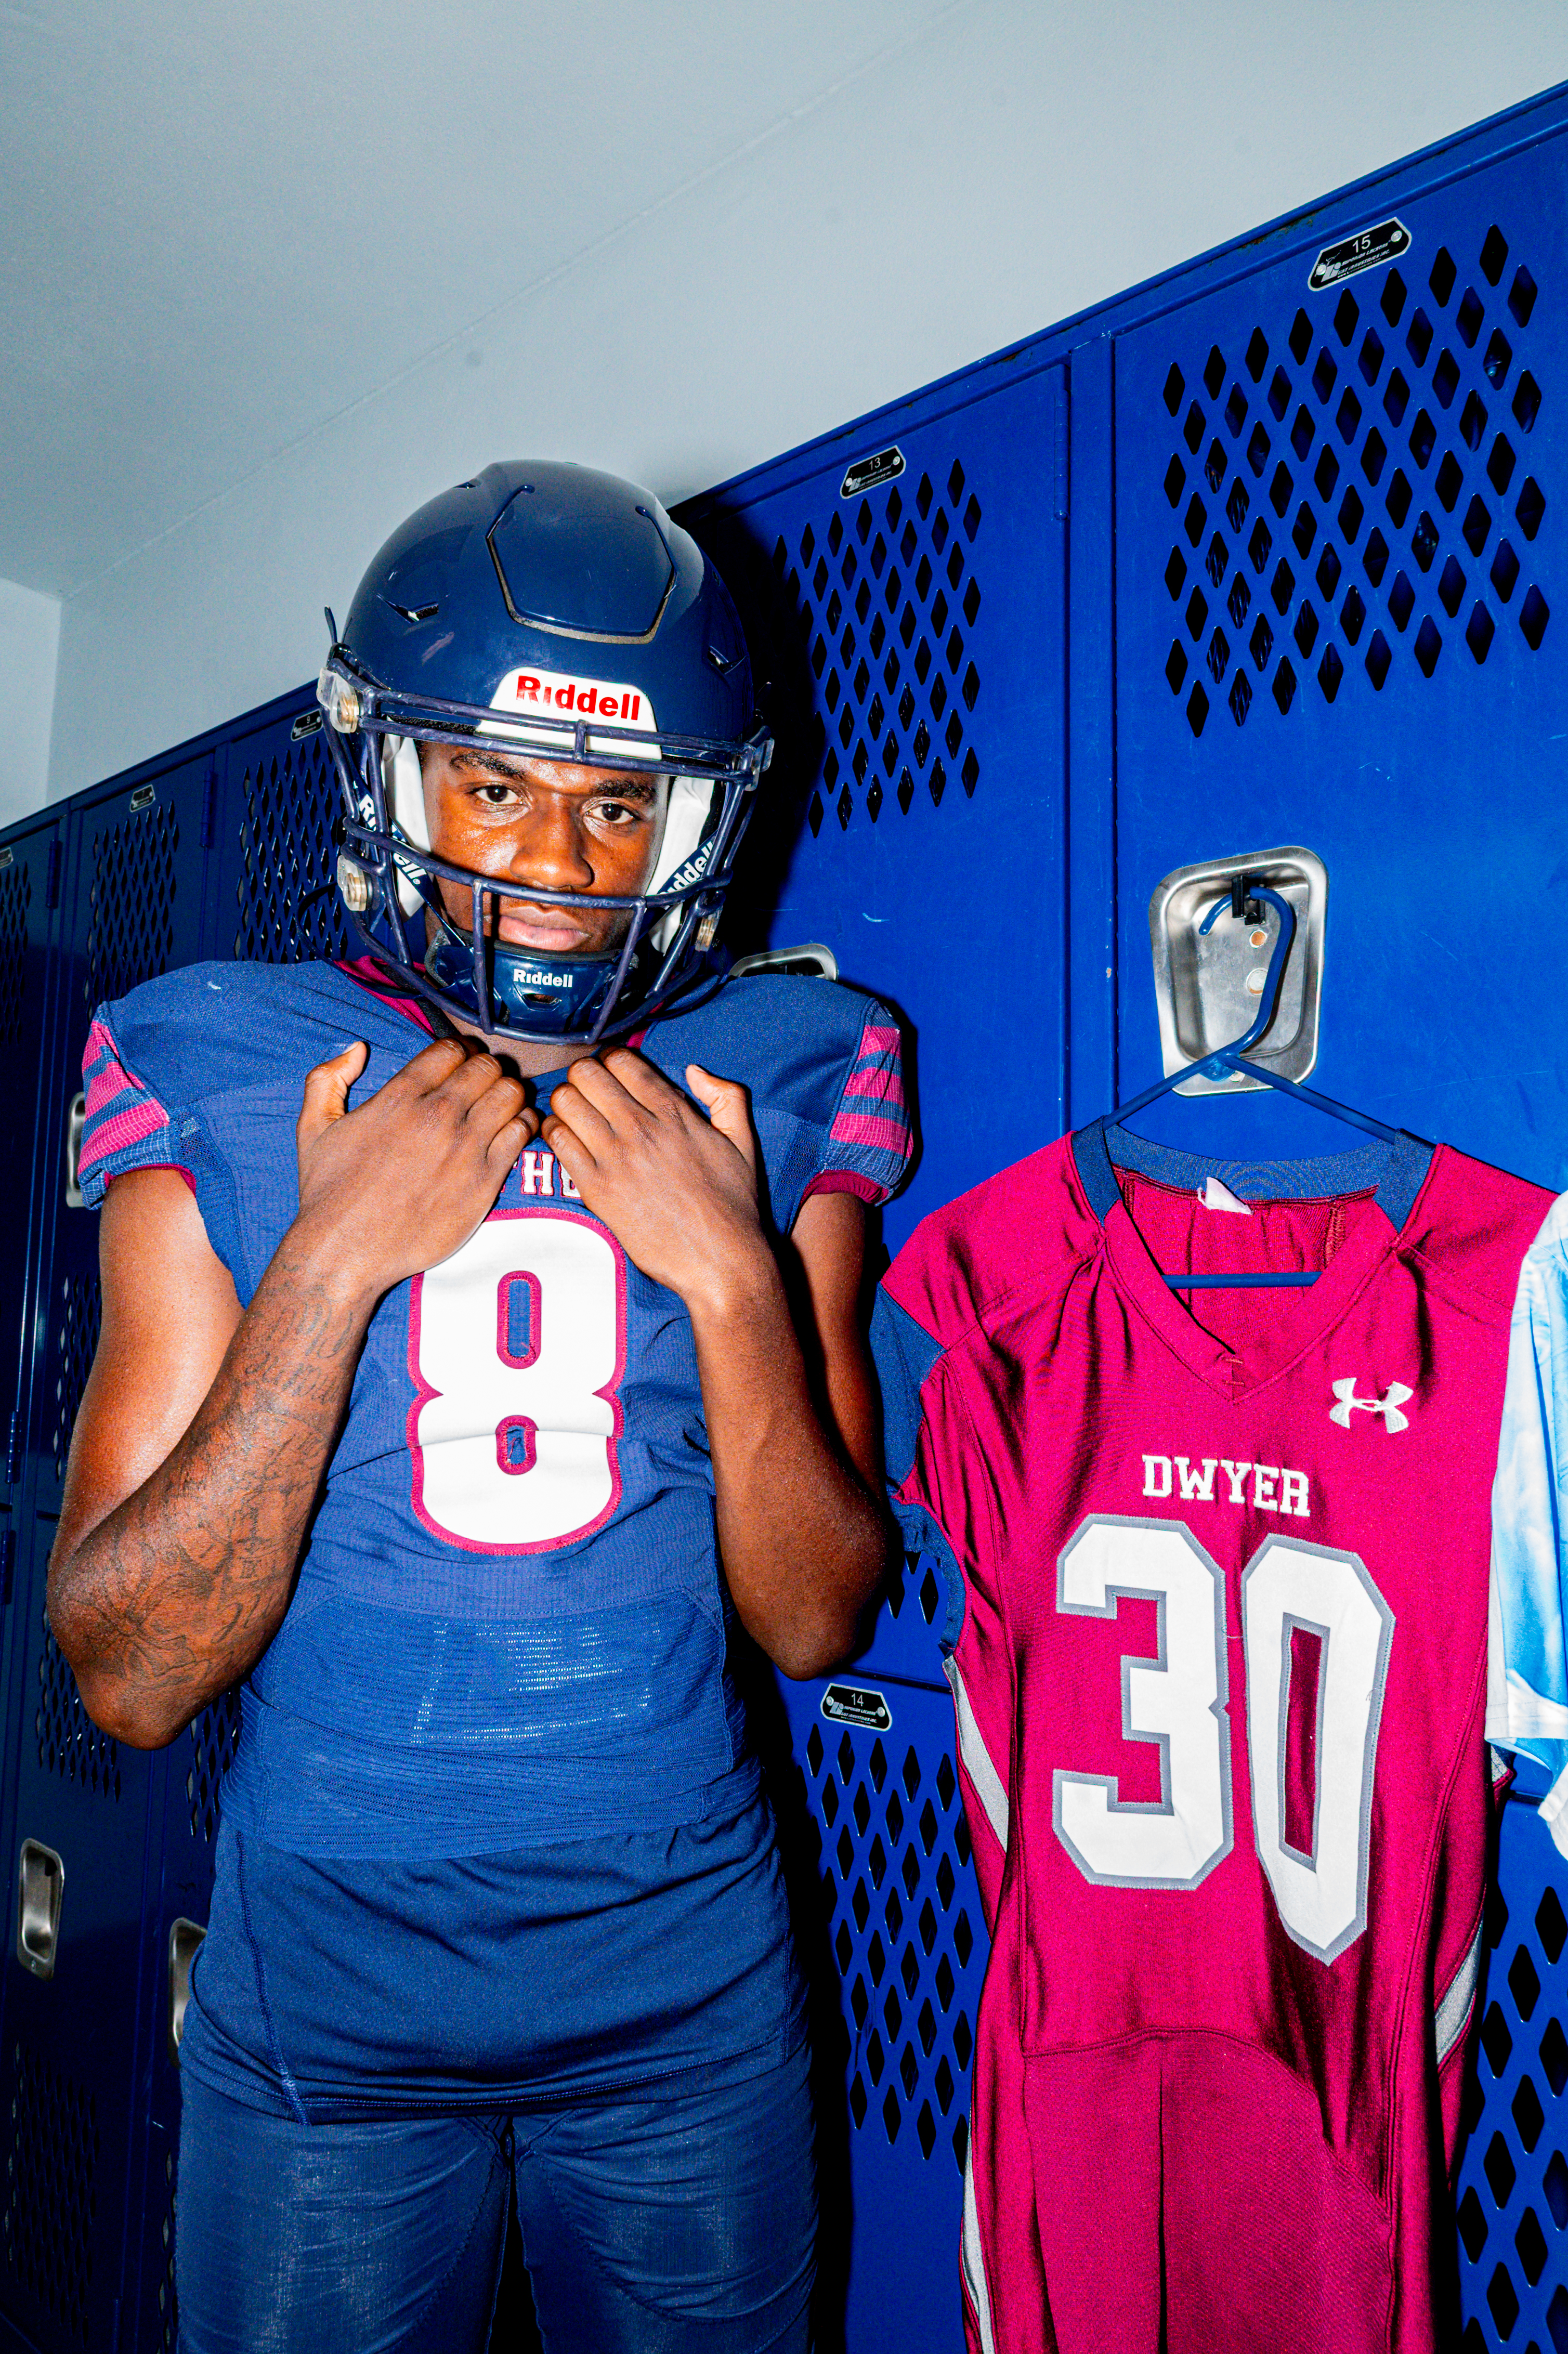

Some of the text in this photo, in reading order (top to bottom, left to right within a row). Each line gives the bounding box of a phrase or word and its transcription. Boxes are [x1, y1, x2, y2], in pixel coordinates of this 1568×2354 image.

[1352, 234, 1371, 253] 15
[869, 457, 881, 470] 13
[516, 675, 641, 721] Riddell
[306, 715, 311, 724] 9
[513, 968, 573, 988] Riddell
[406, 1206, 627, 1555] 8
[1142, 1454, 1311, 1517] DWYER
[851, 1693, 864, 1707] 14
[1052, 1513, 1396, 1967] 30
